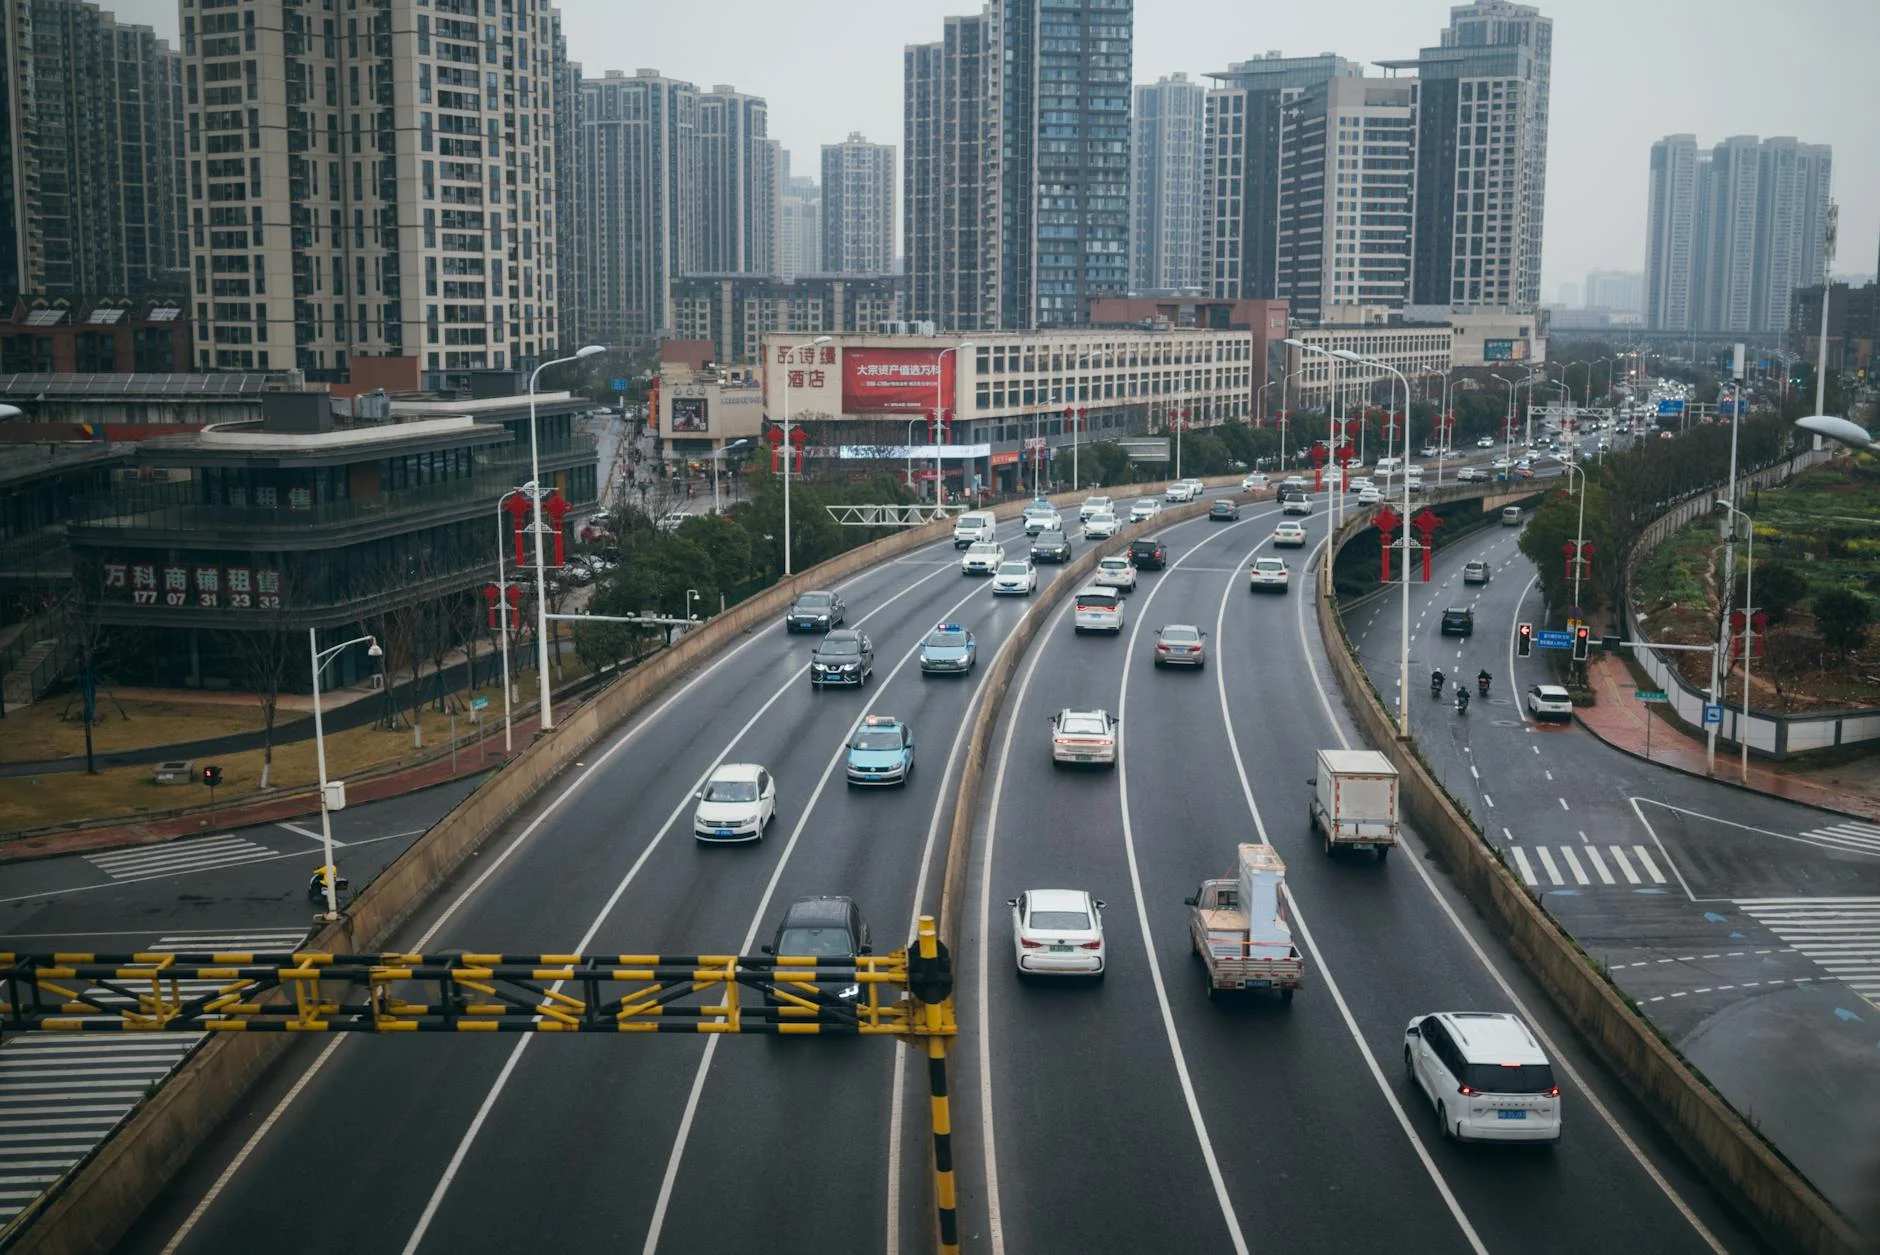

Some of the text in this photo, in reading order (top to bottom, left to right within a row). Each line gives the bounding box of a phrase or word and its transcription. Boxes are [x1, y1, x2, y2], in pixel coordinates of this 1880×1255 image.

[787, 370, 825, 388] 酒店
[104, 564, 281, 593] 万科商铺租售
[133, 591, 280, 609] 177 07 31 23 32
